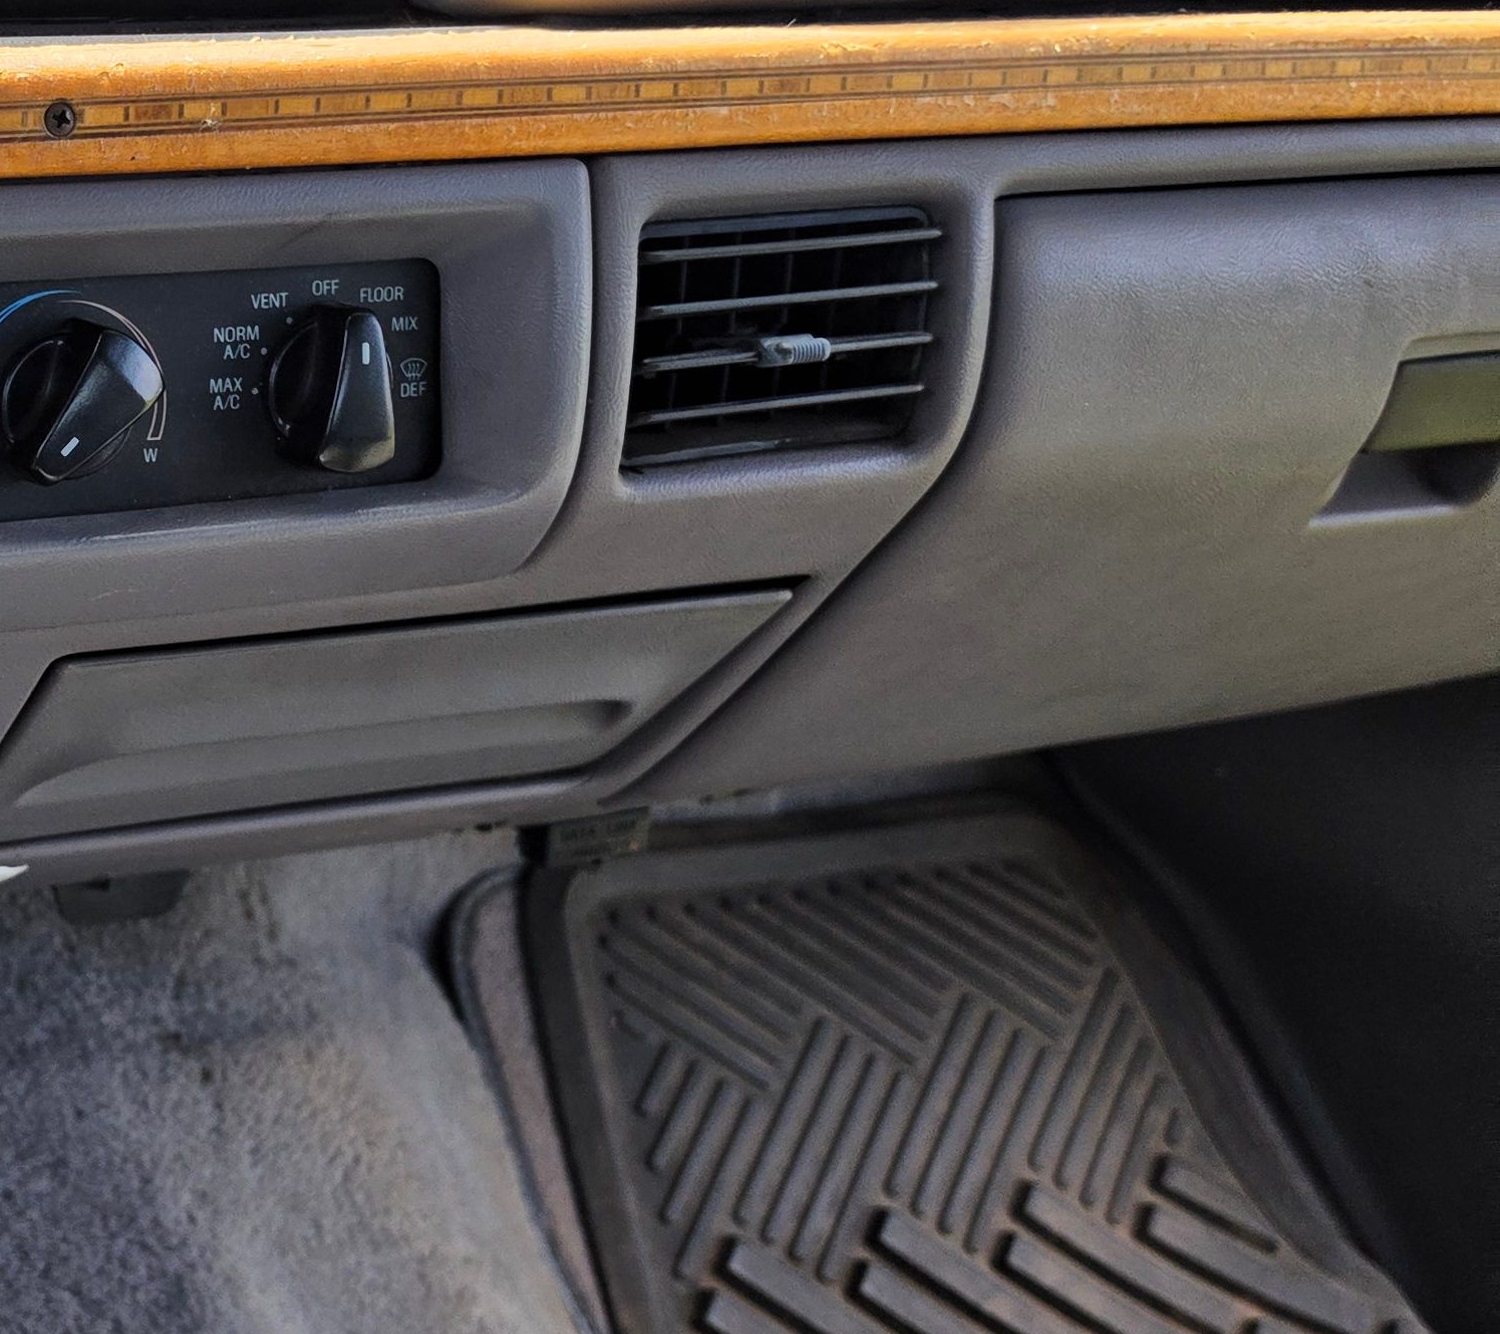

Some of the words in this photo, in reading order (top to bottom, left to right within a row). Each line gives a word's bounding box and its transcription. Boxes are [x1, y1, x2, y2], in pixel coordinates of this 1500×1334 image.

[311, 279, 340, 296] OFF
[359, 286, 404, 303] FLOOR
[251, 292, 289, 309] VENT
[391, 317, 419, 332] MIX
[213, 325, 260, 343] NORM
[223, 344, 251, 360] A/C
[209, 378, 243, 394] MAX
[400, 381, 428, 398] DEF
[213, 395, 241, 411] A/C
[143, 448, 159, 463] W
